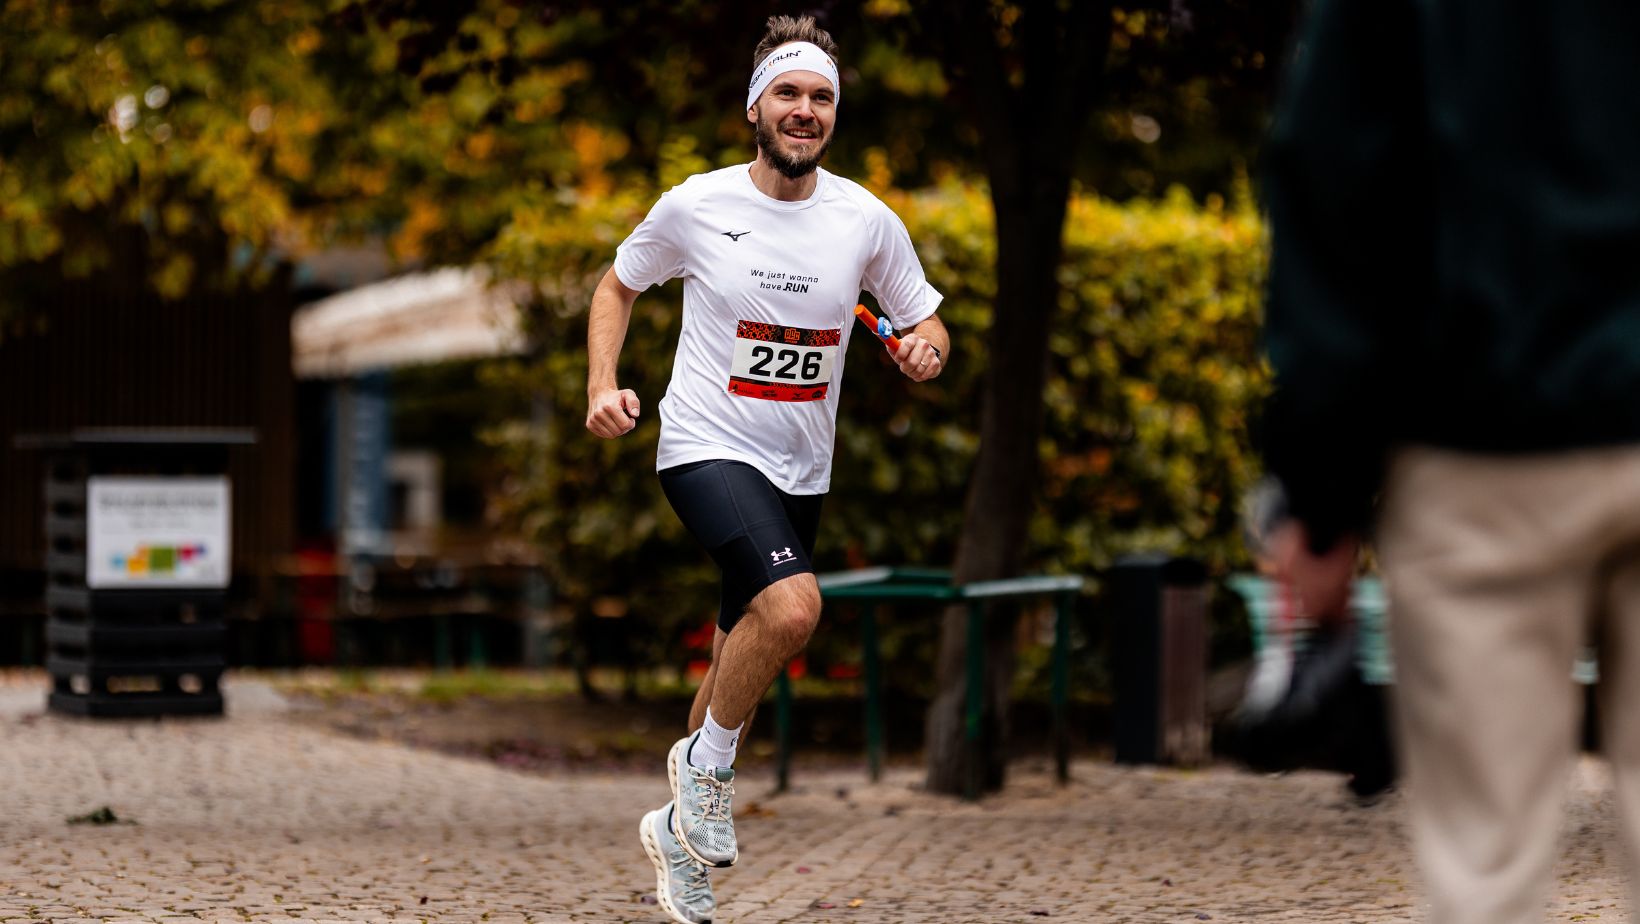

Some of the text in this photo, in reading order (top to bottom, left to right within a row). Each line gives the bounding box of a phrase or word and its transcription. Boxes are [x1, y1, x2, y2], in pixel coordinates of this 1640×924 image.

[750, 269, 819, 283] We just wanna
[760, 282, 782, 290] have
[749, 346, 822, 380] 226
